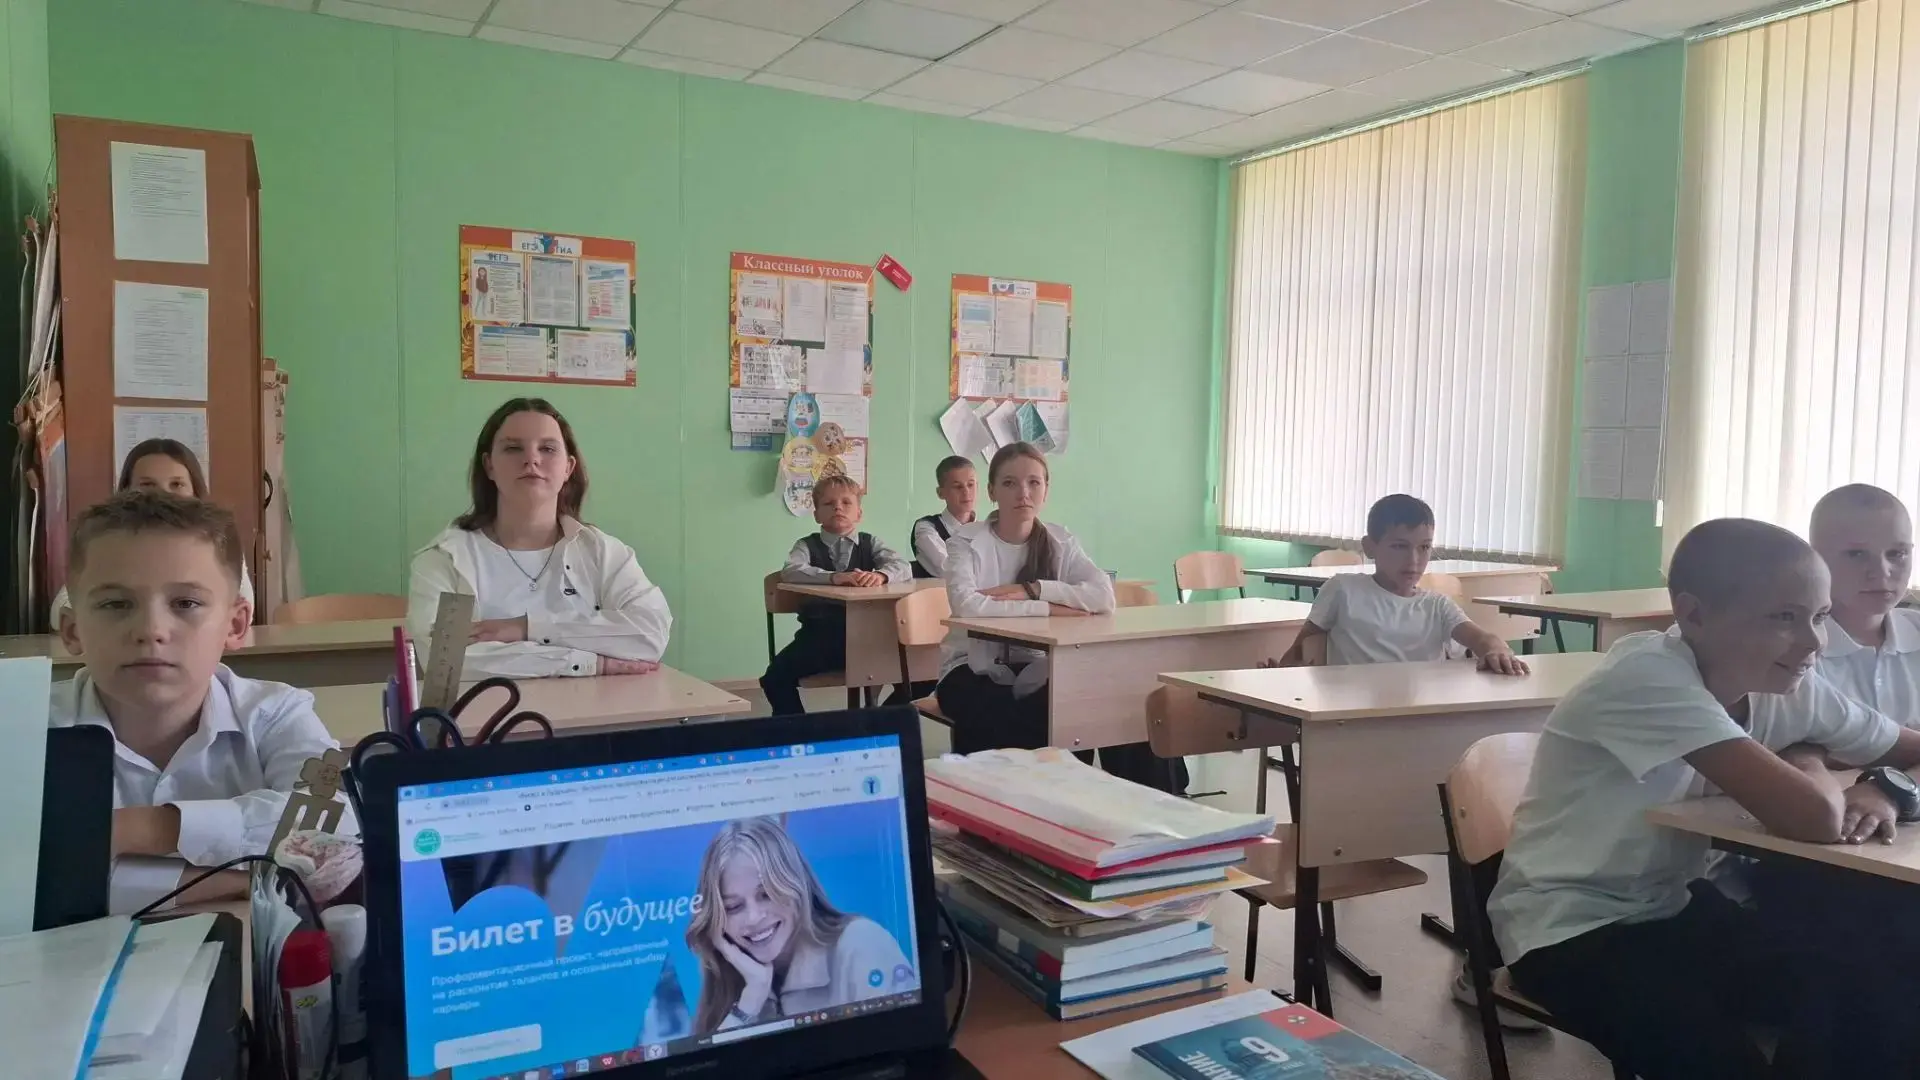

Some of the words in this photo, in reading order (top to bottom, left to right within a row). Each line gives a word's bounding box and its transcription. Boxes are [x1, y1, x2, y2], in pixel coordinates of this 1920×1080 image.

[743, 255, 814, 274] Классный
[818, 266, 864, 280] уголок
[431, 918, 543, 956] Билет
[554, 915, 574, 936] в
[584, 894, 704, 936] будущее
